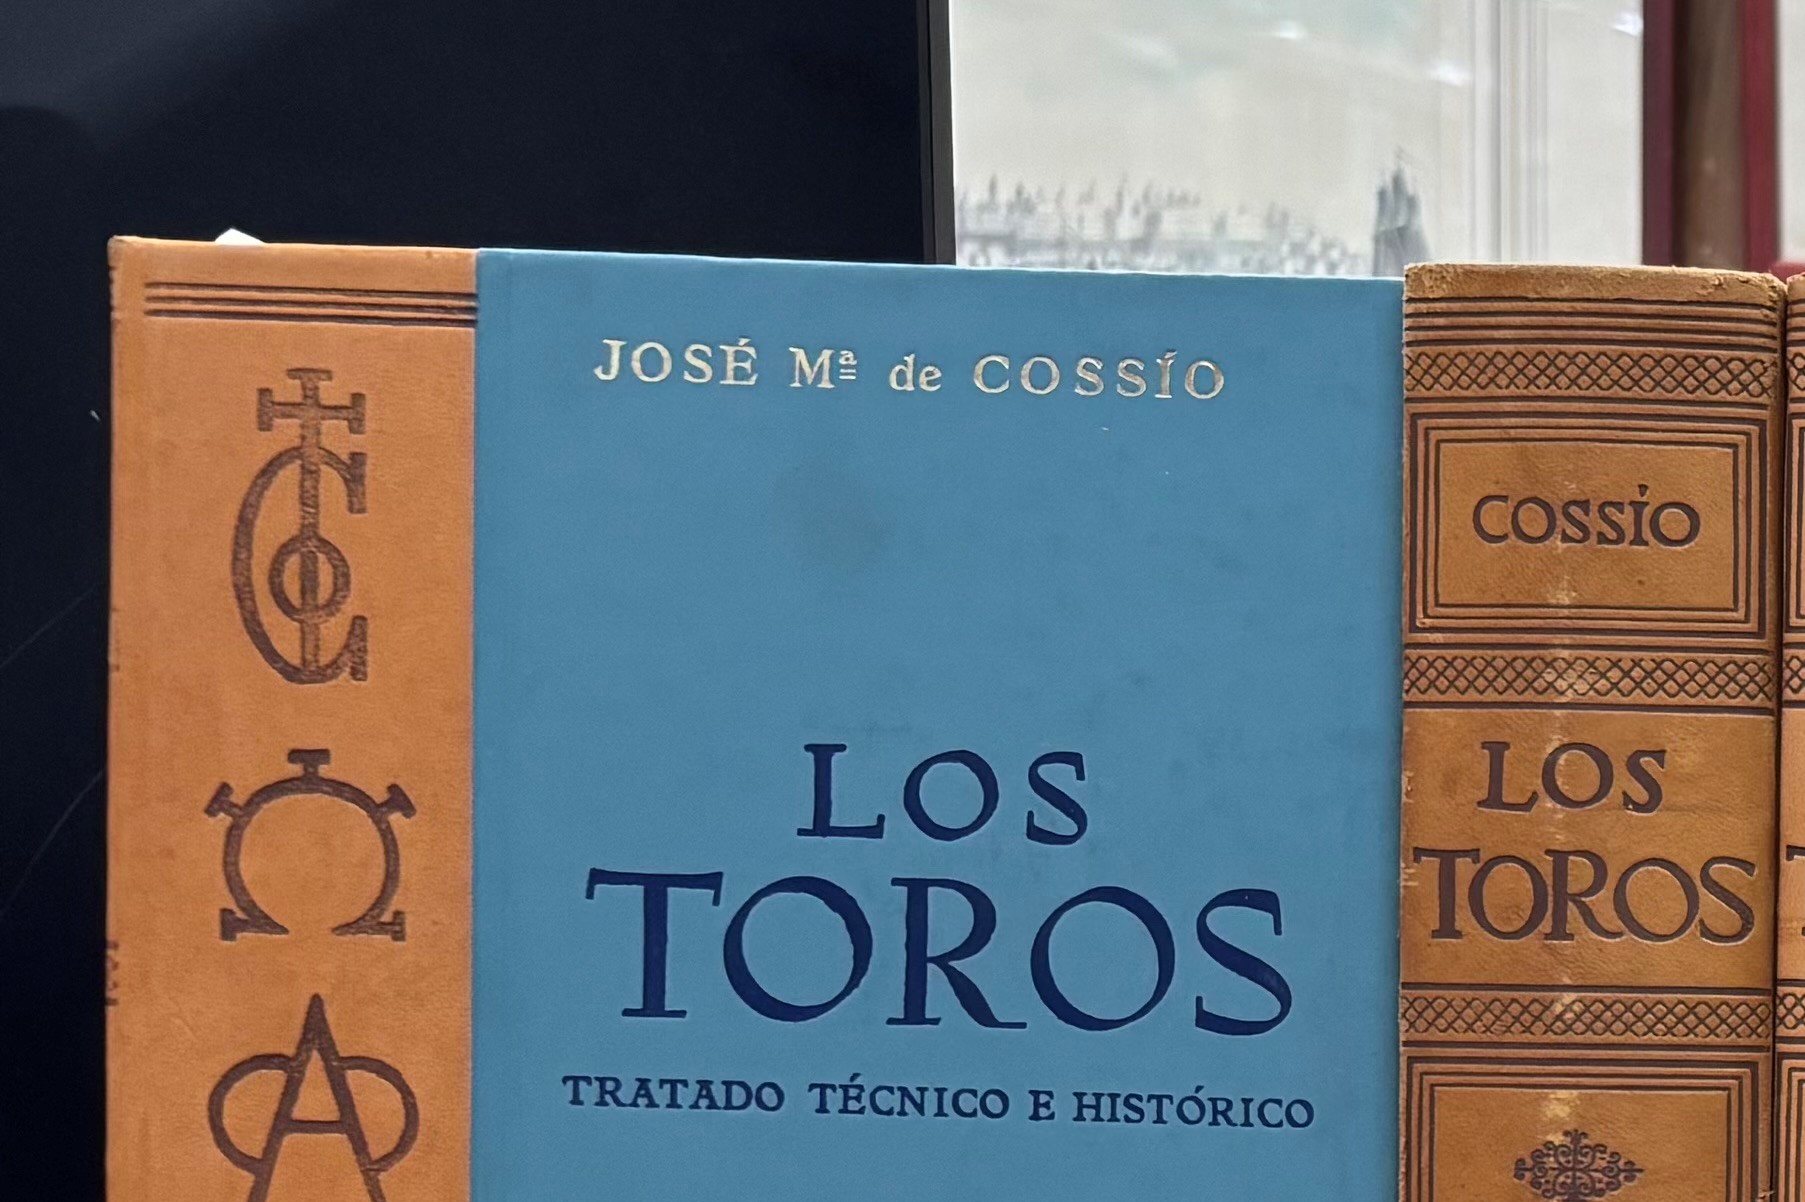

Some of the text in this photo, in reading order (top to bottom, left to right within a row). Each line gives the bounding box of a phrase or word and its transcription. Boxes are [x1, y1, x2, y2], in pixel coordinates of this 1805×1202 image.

[593, 338, 1226, 400] JOSÉ Mª de COSSÍO
[1472, 485, 1701, 549] COSSÍO
[797, 743, 1088, 846] LOS
[1477, 740, 1667, 814] LOS
[1412, 847, 1757, 943] TOROS
[585, 867, 1294, 1036] TOROS
[562, 1074, 1315, 1129] TRATADO TÉCNICO E HISTÓRICO
